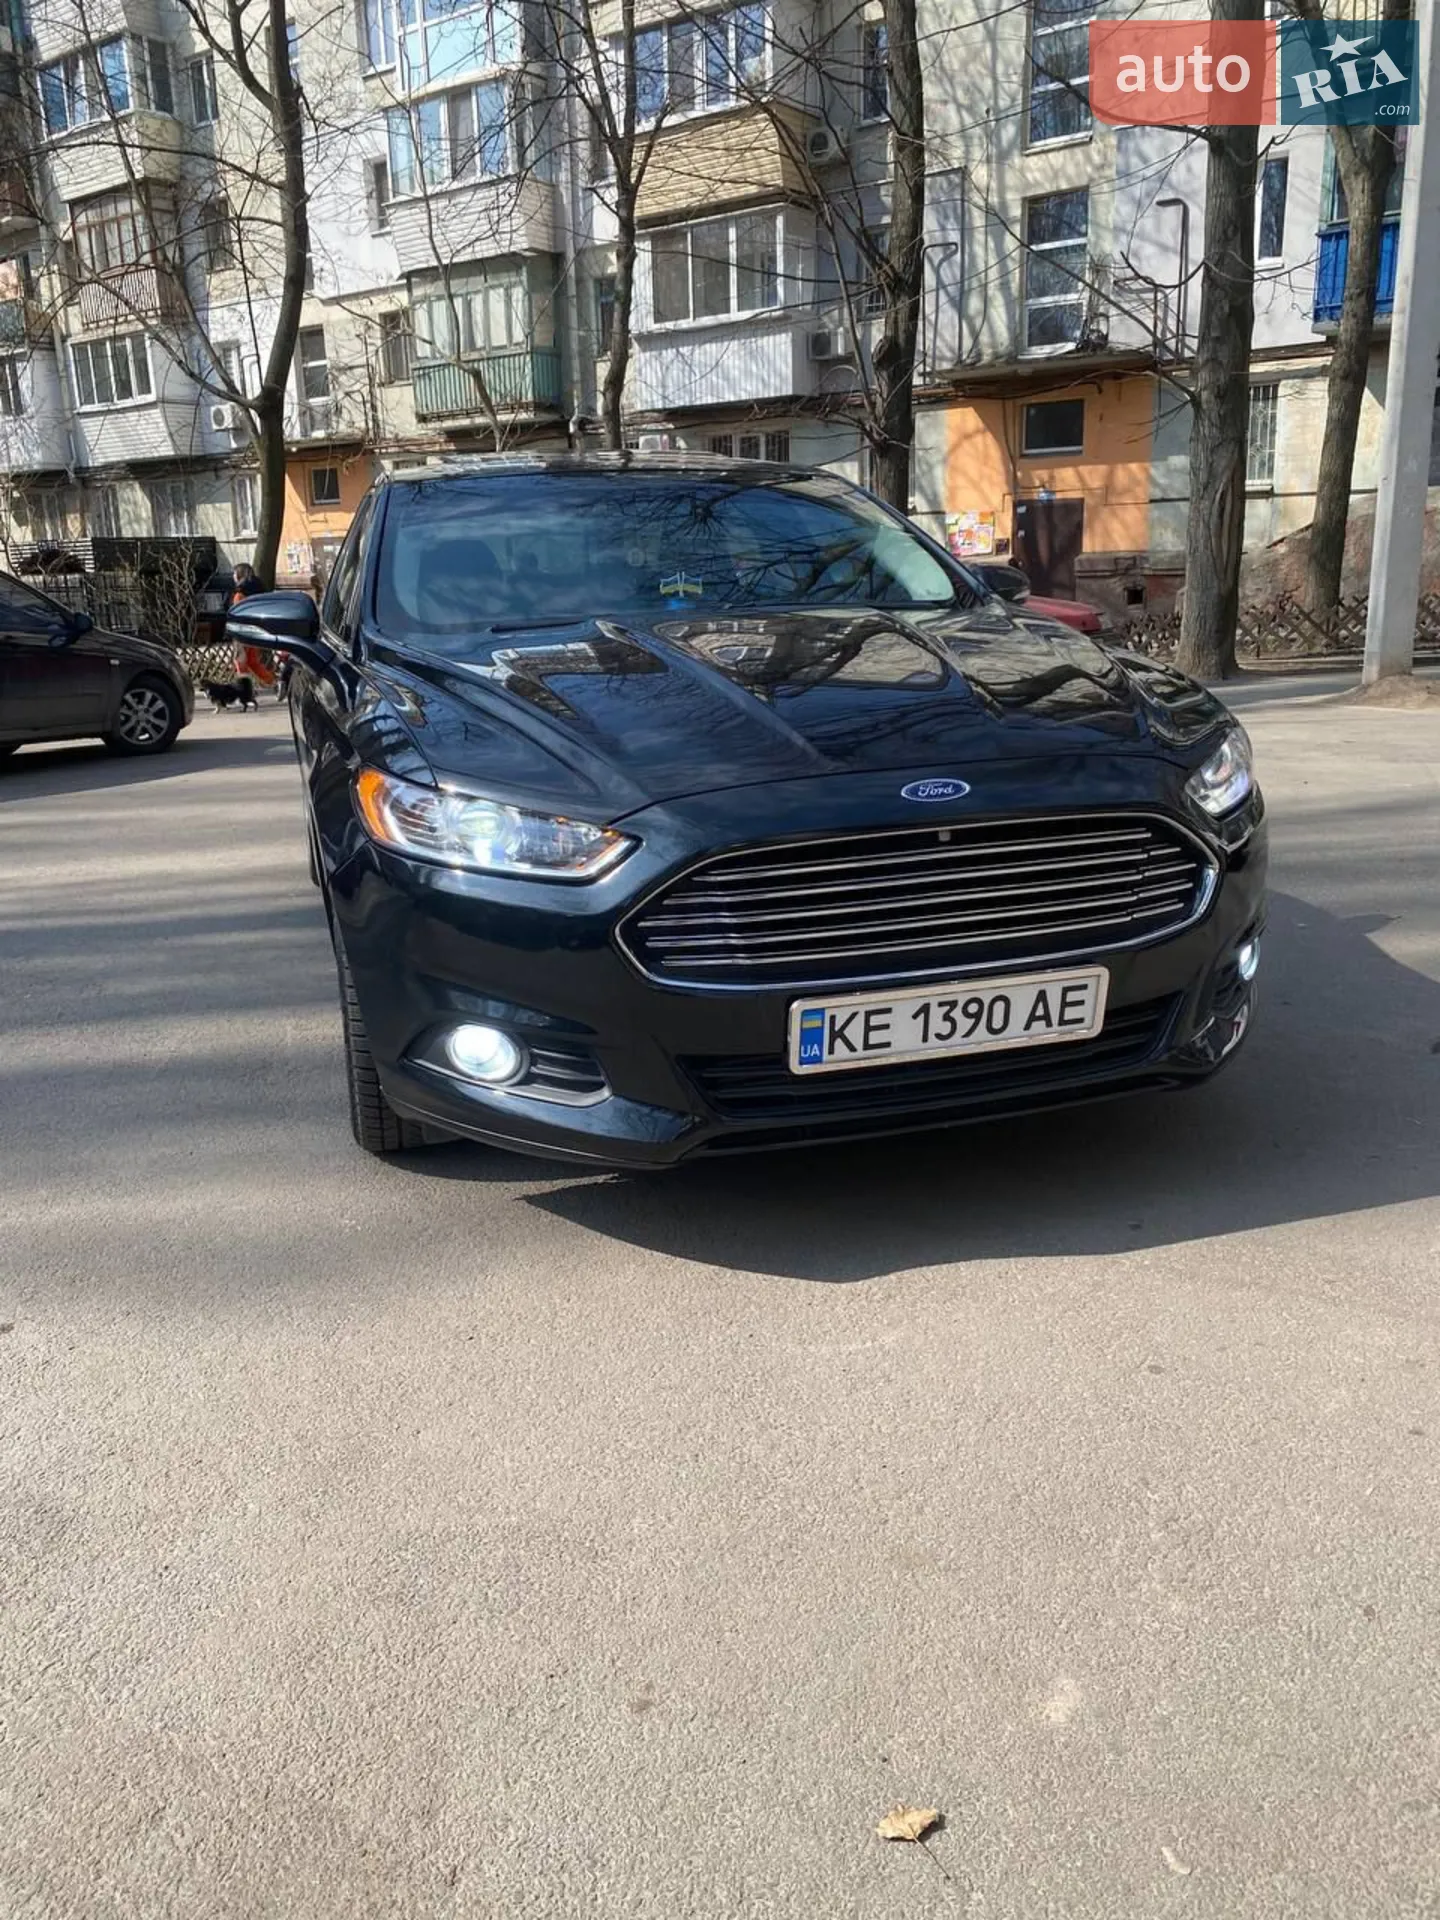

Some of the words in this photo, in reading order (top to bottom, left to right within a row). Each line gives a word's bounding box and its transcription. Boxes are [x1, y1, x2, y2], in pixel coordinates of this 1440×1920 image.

[917, 782, 955, 797] Ford
[827, 1006, 894, 1056] KE
[911, 994, 1012, 1044] 1390
[1023, 983, 1089, 1032] AE
[801, 1043, 821, 1058] UA
